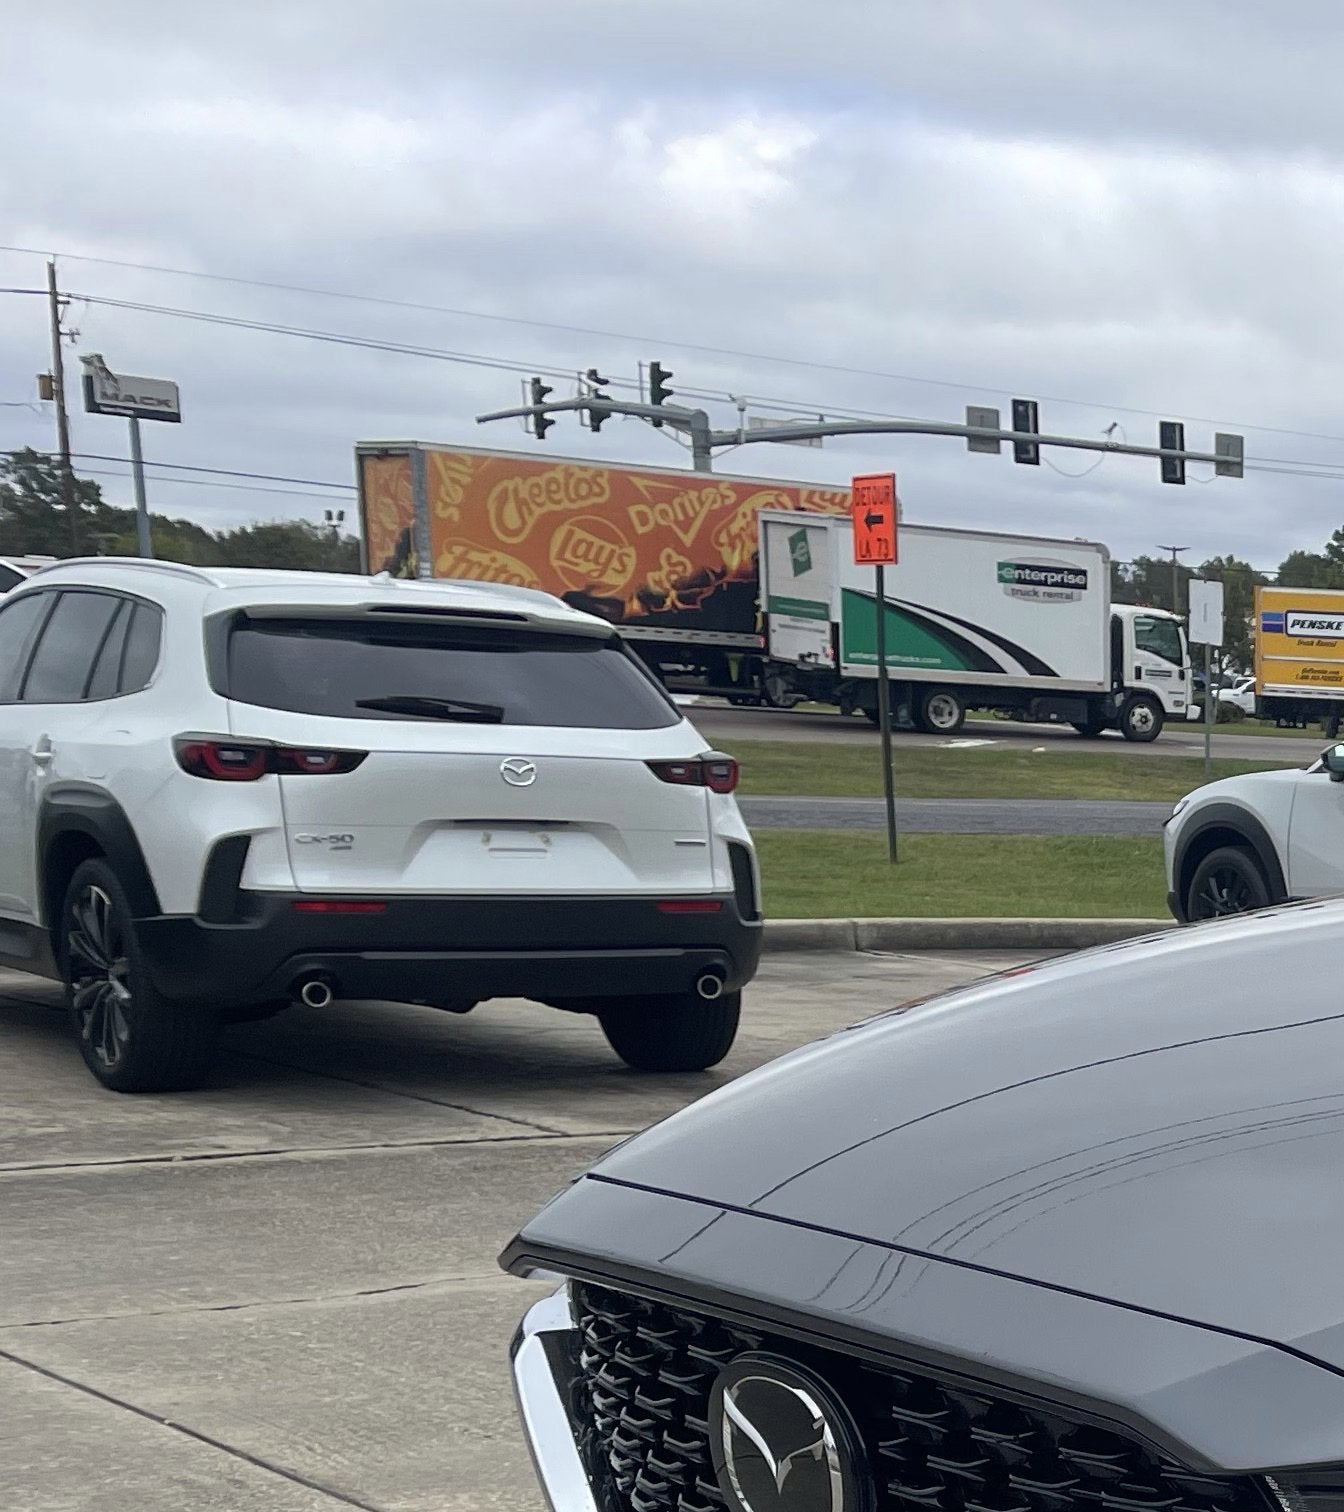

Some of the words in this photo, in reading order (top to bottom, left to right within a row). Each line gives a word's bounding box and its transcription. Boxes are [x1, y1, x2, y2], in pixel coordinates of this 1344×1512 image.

[100, 391, 172, 408] MACK
[490, 466, 608, 541] Cheetos
[854, 485, 890, 506] DETOUR
[628, 481, 737, 535] Doritos
[859, 540, 872, 558] LA
[877, 538, 889, 558] 73
[999, 568, 1086, 585] enterprise
[1011, 588, 1040, 597] truck
[1043, 591, 1074, 600] rental
[1290, 619, 1344, 630] PENSKE
[294, 833, 354, 845] CX-50
